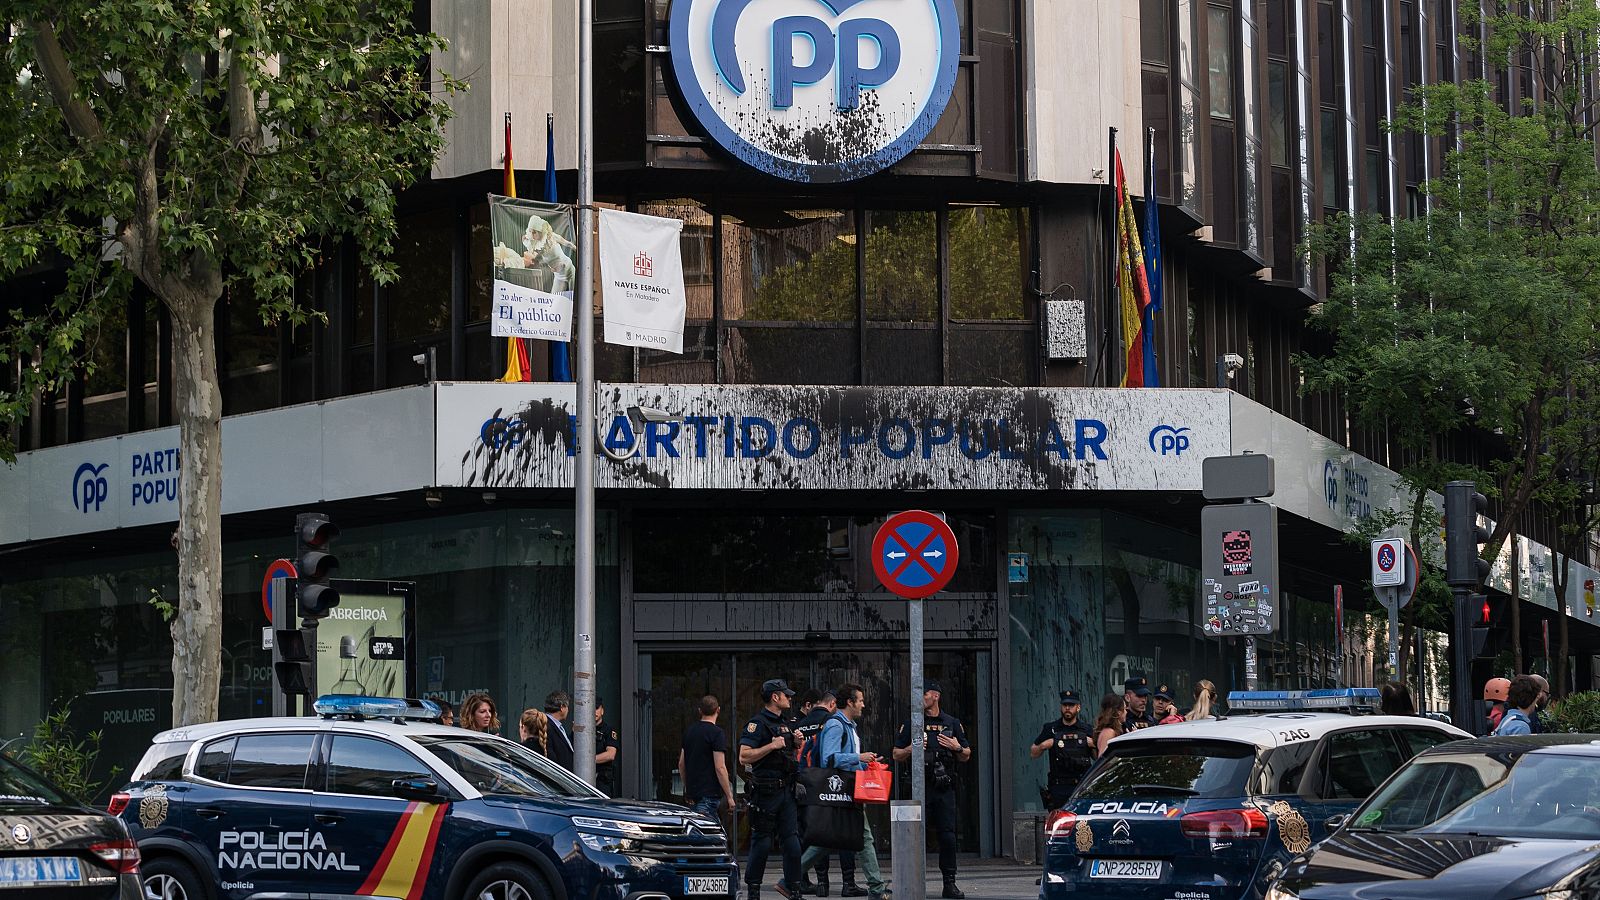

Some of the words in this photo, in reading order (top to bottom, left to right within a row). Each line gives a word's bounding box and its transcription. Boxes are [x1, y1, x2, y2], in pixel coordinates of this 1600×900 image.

[614, 280, 638, 290] NAVES
[640, 284, 671, 295] ESPAÑOL
[538, 297, 554, 307] may
[499, 305, 513, 320] El
[518, 307, 562, 325] público
[635, 333, 667, 345] MADRID
[567, 414, 821, 460] ARTIDO
[133, 448, 181, 477] PARTI
[133, 478, 180, 506] POPU
[103, 708, 156, 724] POPULARES
[1279, 728, 1311, 743] 2AG
[1088, 801, 1168, 815] POLICÍA
[219, 828, 327, 850] POLICÍA
[218, 851, 360, 871] NACIONAL
[221, 881, 254, 889] @policia
[1175, 891, 1210, 899] @policia
